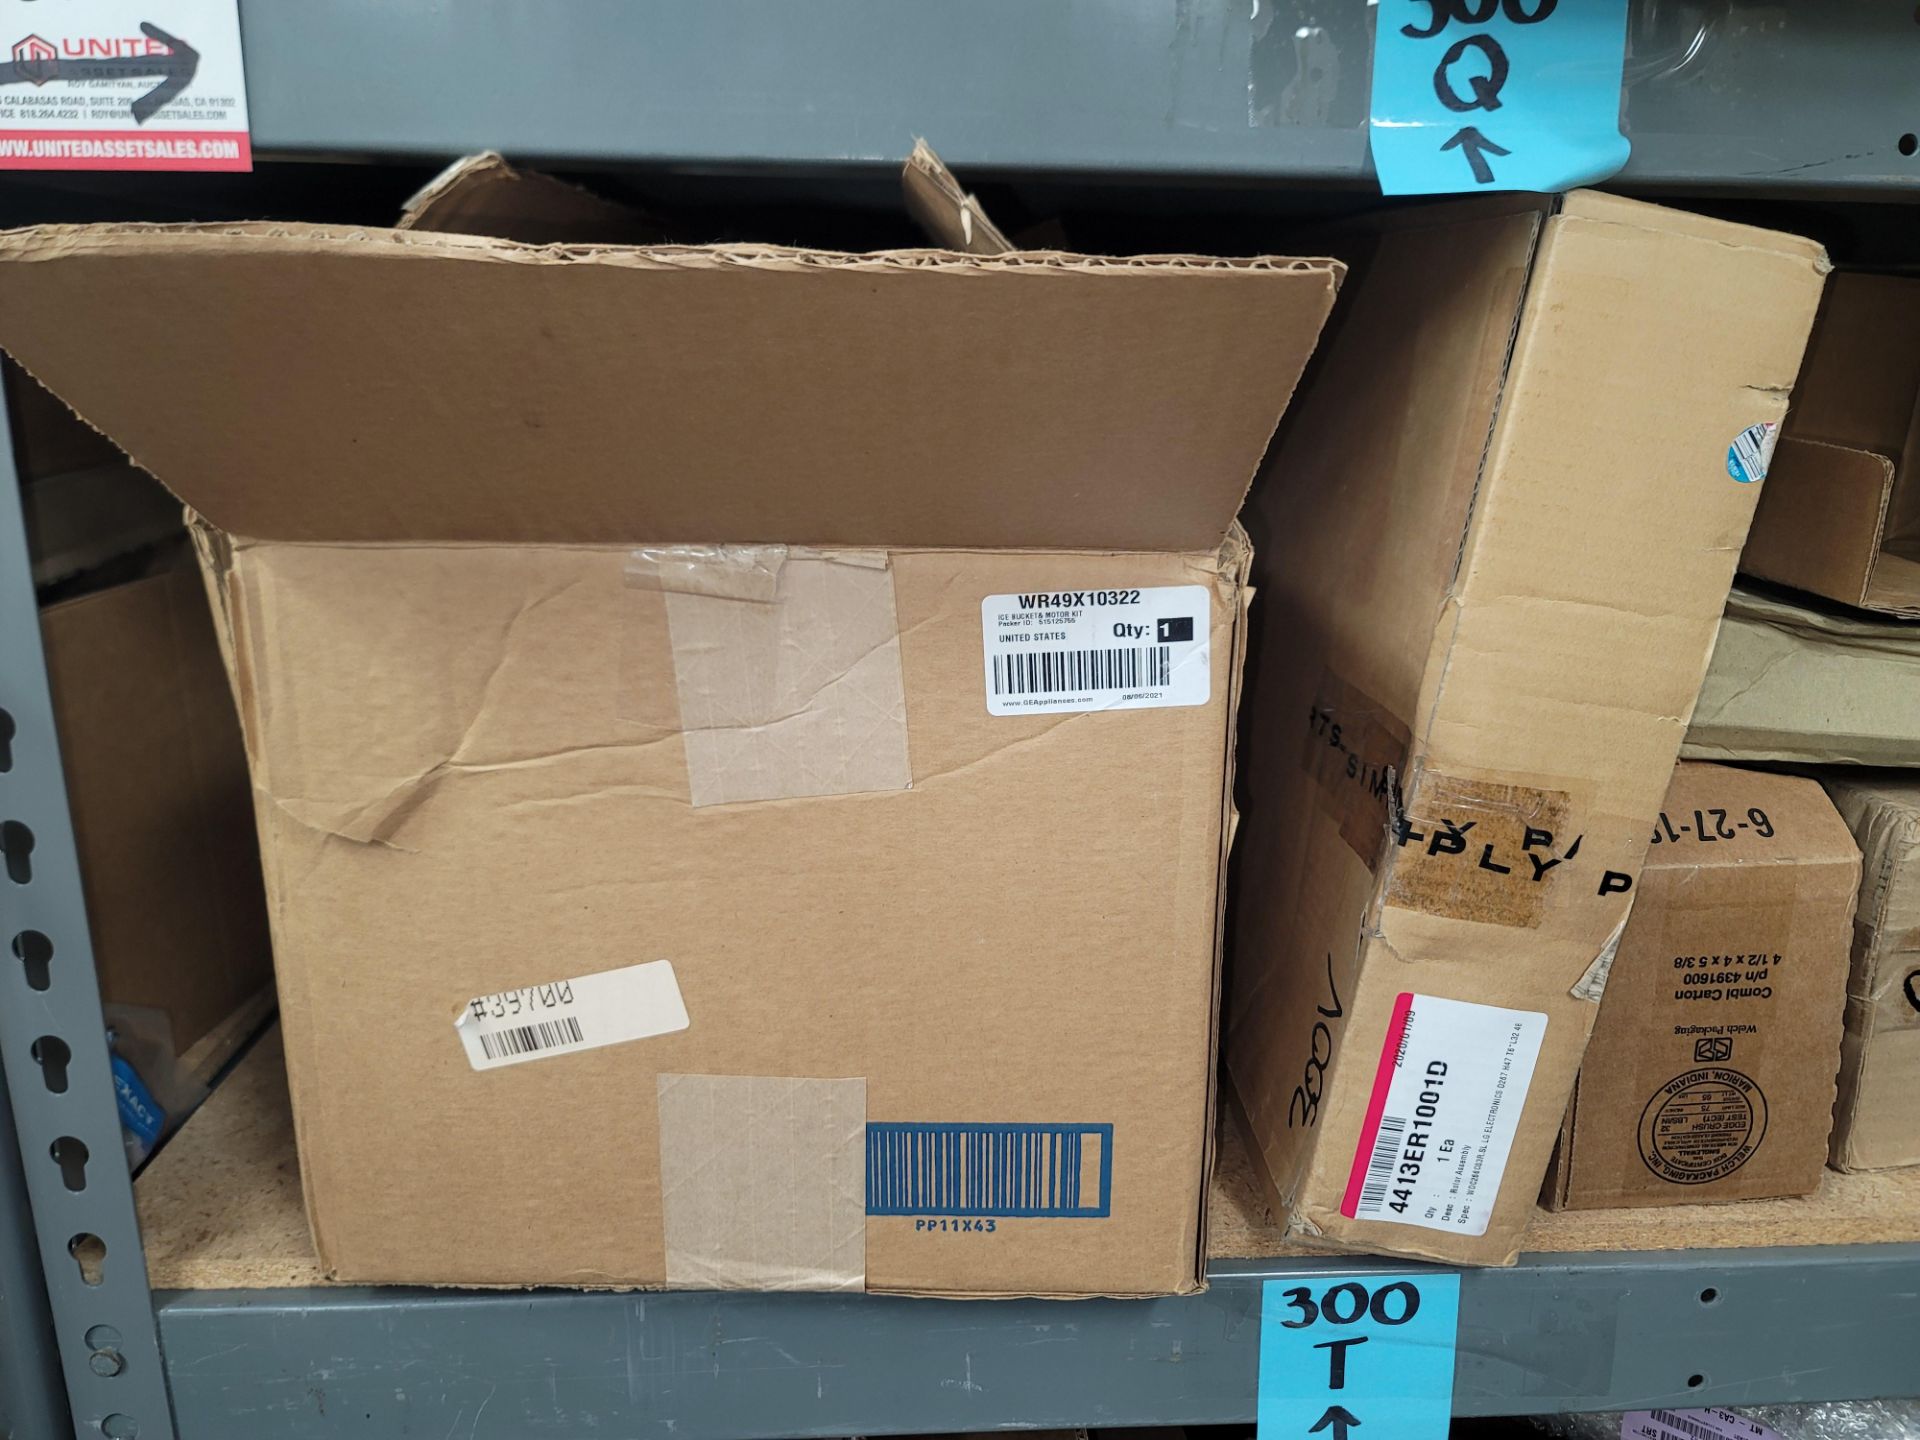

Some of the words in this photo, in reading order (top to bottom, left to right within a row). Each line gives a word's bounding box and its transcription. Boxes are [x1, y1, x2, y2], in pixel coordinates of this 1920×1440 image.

[63, 38, 186, 57] UNITE
[1434, 34, 1509, 112] Q
[1018, 590, 1140, 609] WR49X10322
[1045, 610, 1070, 618] MOTOR
[1113, 622, 1150, 639] Qty:
[1159, 623, 1170, 638] 1
[999, 633, 1031, 643] UNITED
[1034, 632, 1066, 641] STATES
[1650, 807, 1775, 844] 6-27-1
[1673, 956, 1696, 969] 3/8
[1698, 956, 1708, 968] 5
[1711, 956, 1720, 965] x
[1724, 955, 1733, 967] 4
[1735, 955, 1745, 964] x
[1748, 953, 1768, 966] 1/2
[1772, 953, 1782, 965] 4
[1683, 972, 1742, 985] 4391600
[1745, 968, 1768, 982] p/n
[1674, 989, 1723, 1001] Carton
[1674, 1025, 1724, 1036] Packaging
[1726, 1025, 1757, 1035] Welch
[1664, 1071, 1709, 1095] INDIANA
[1711, 1070, 1753, 1093] MARION,
[1729, 1113, 1747, 1121] TEST
[1692, 1121, 1721, 1131] CRUSH
[1722, 1121, 1747, 1130] EDGE
[1389, 1060, 1449, 1214] 4413ER1001D
[1439, 1138, 1455, 1153] Ea
[1457, 1205, 1471, 1224] Spec
[1484, 1090, 1504, 1133] ELECTRONICS
[1721, 1144, 1753, 1173] WELCH
[1441, 1203, 1454, 1222] Desc
[1455, 1144, 1472, 1175] Assembly
[915, 1219, 997, 1233] PP11X43
[1281, 1281, 1421, 1329] 300
[1313, 1335, 1369, 1390] T
